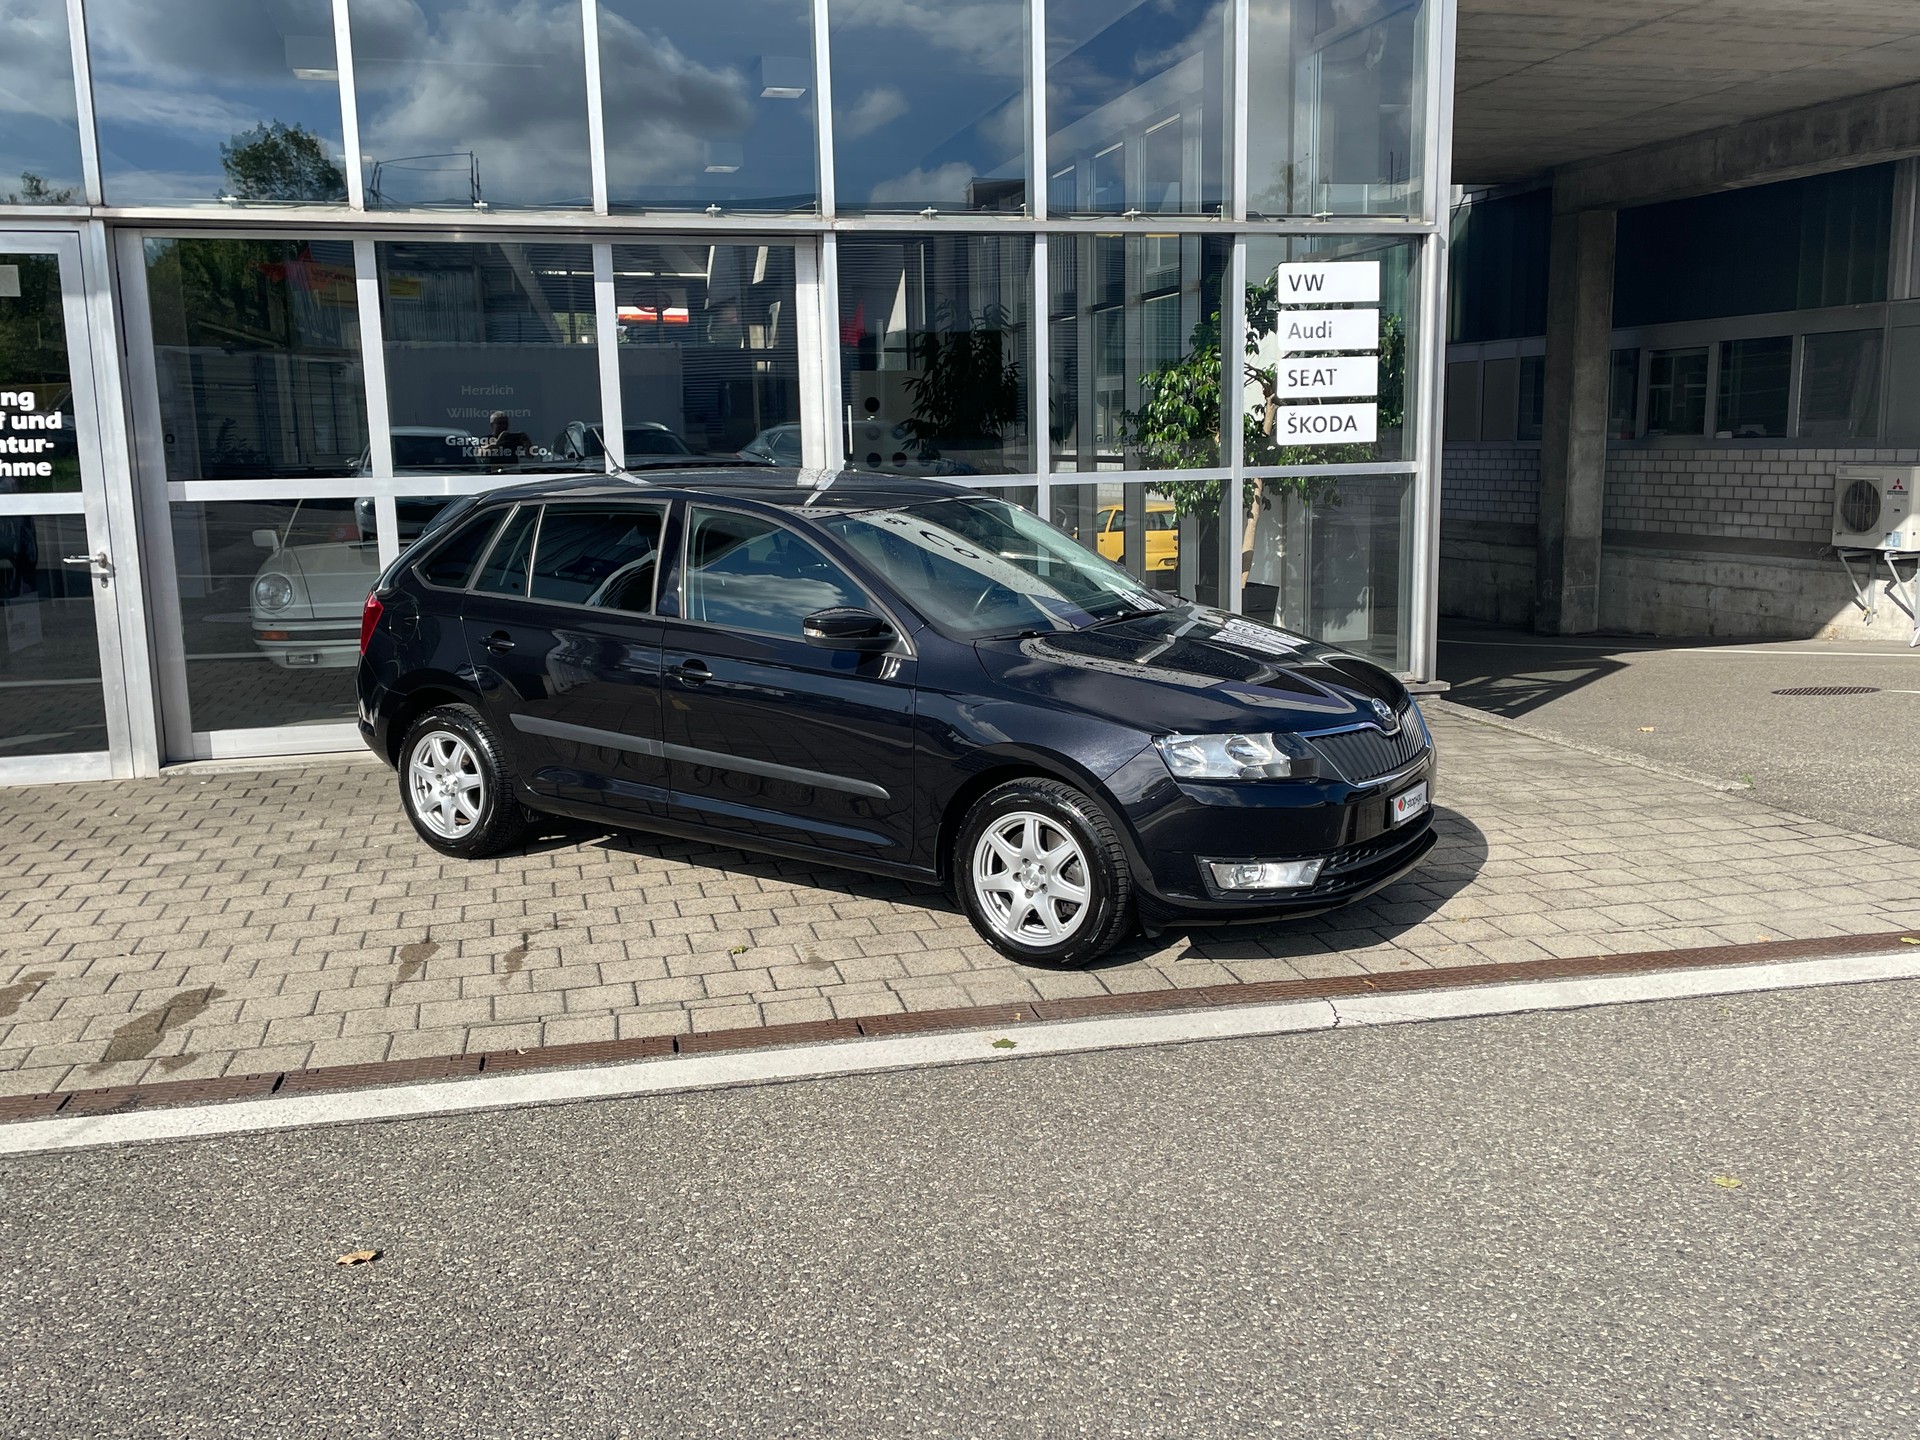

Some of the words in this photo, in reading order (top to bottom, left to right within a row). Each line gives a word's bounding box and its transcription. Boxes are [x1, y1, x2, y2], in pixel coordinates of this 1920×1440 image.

[1288, 273, 1325, 292] VW
[1288, 320, 1333, 339] Audi
[1287, 368, 1338, 387] SEAT
[461, 385, 515, 396] Herzlich
[0, 391, 35, 411] ng
[11, 411, 62, 430] und
[1287, 412, 1358, 434] ŠKODA
[445, 435, 497, 448] Garage
[462, 446, 512, 457] Künzle
[515, 446, 526, 456] &
[529, 446, 552, 456] Co.
[0, 459, 52, 477] hme
